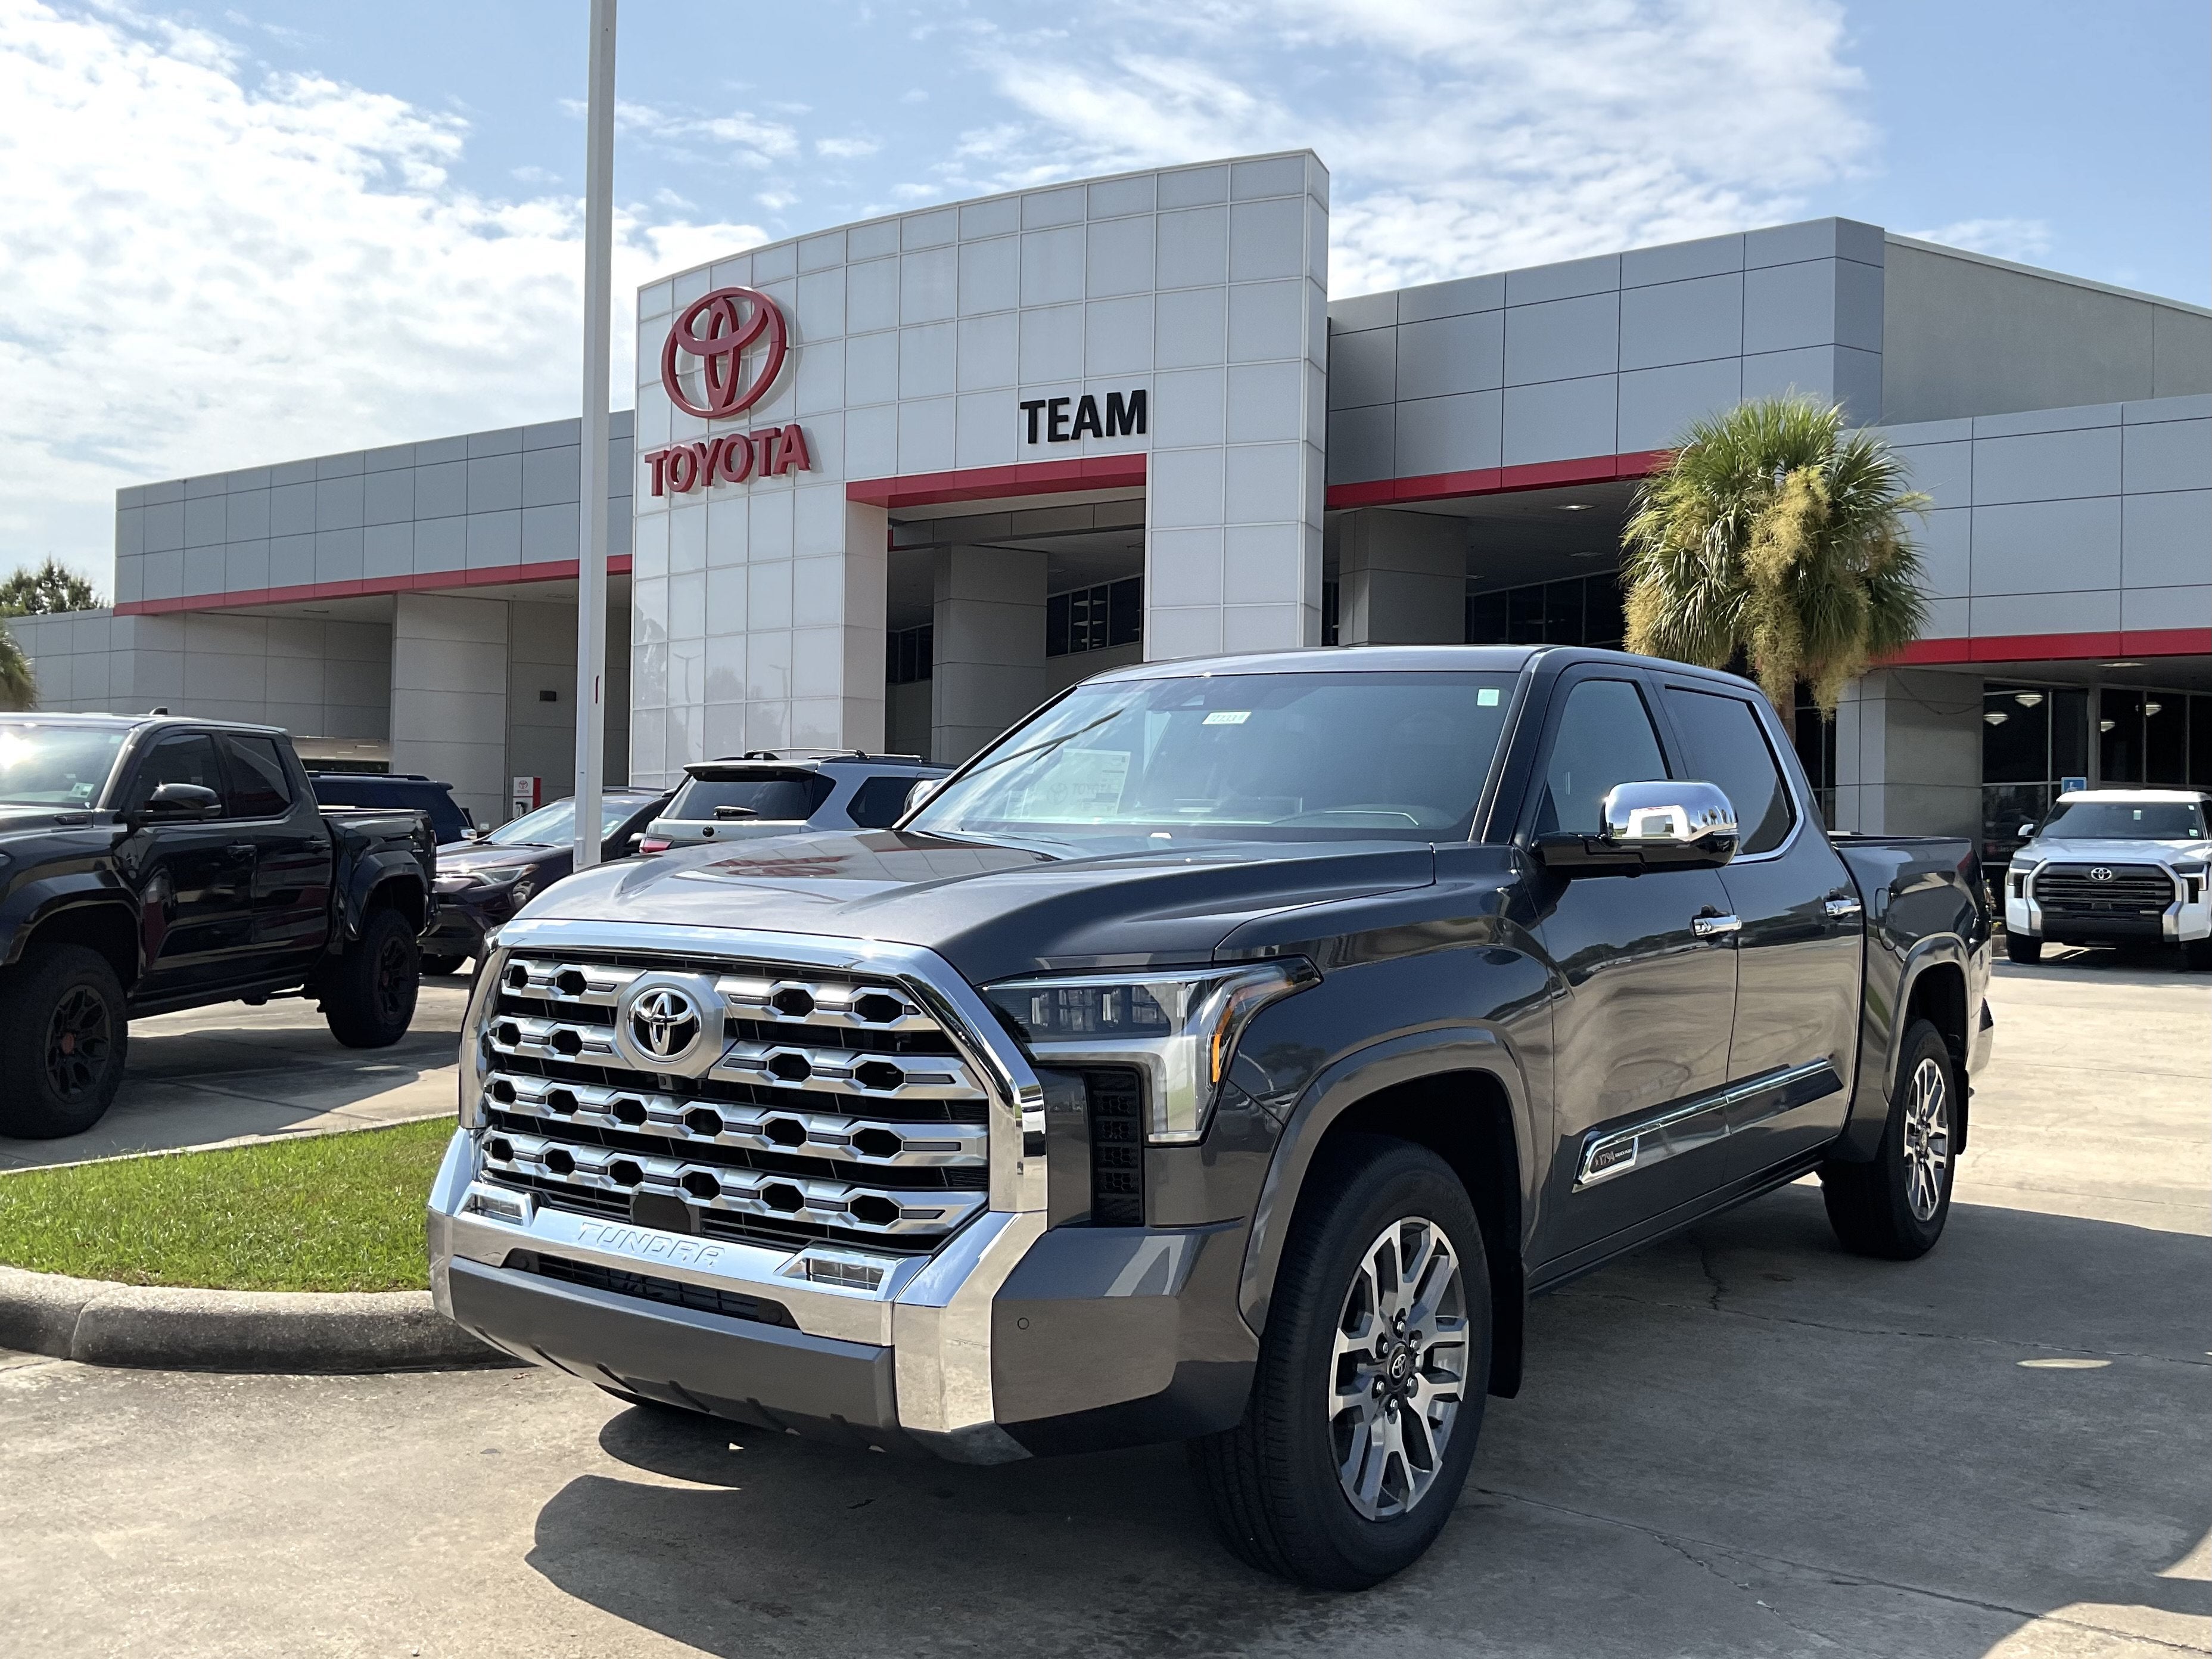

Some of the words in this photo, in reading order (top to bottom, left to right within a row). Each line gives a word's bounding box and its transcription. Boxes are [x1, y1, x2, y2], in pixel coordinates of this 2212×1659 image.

[1020, 389, 1147, 445] TEAM
[644, 424, 811, 497] TOYOTA
[577, 1222, 726, 1268] TUNDRA
